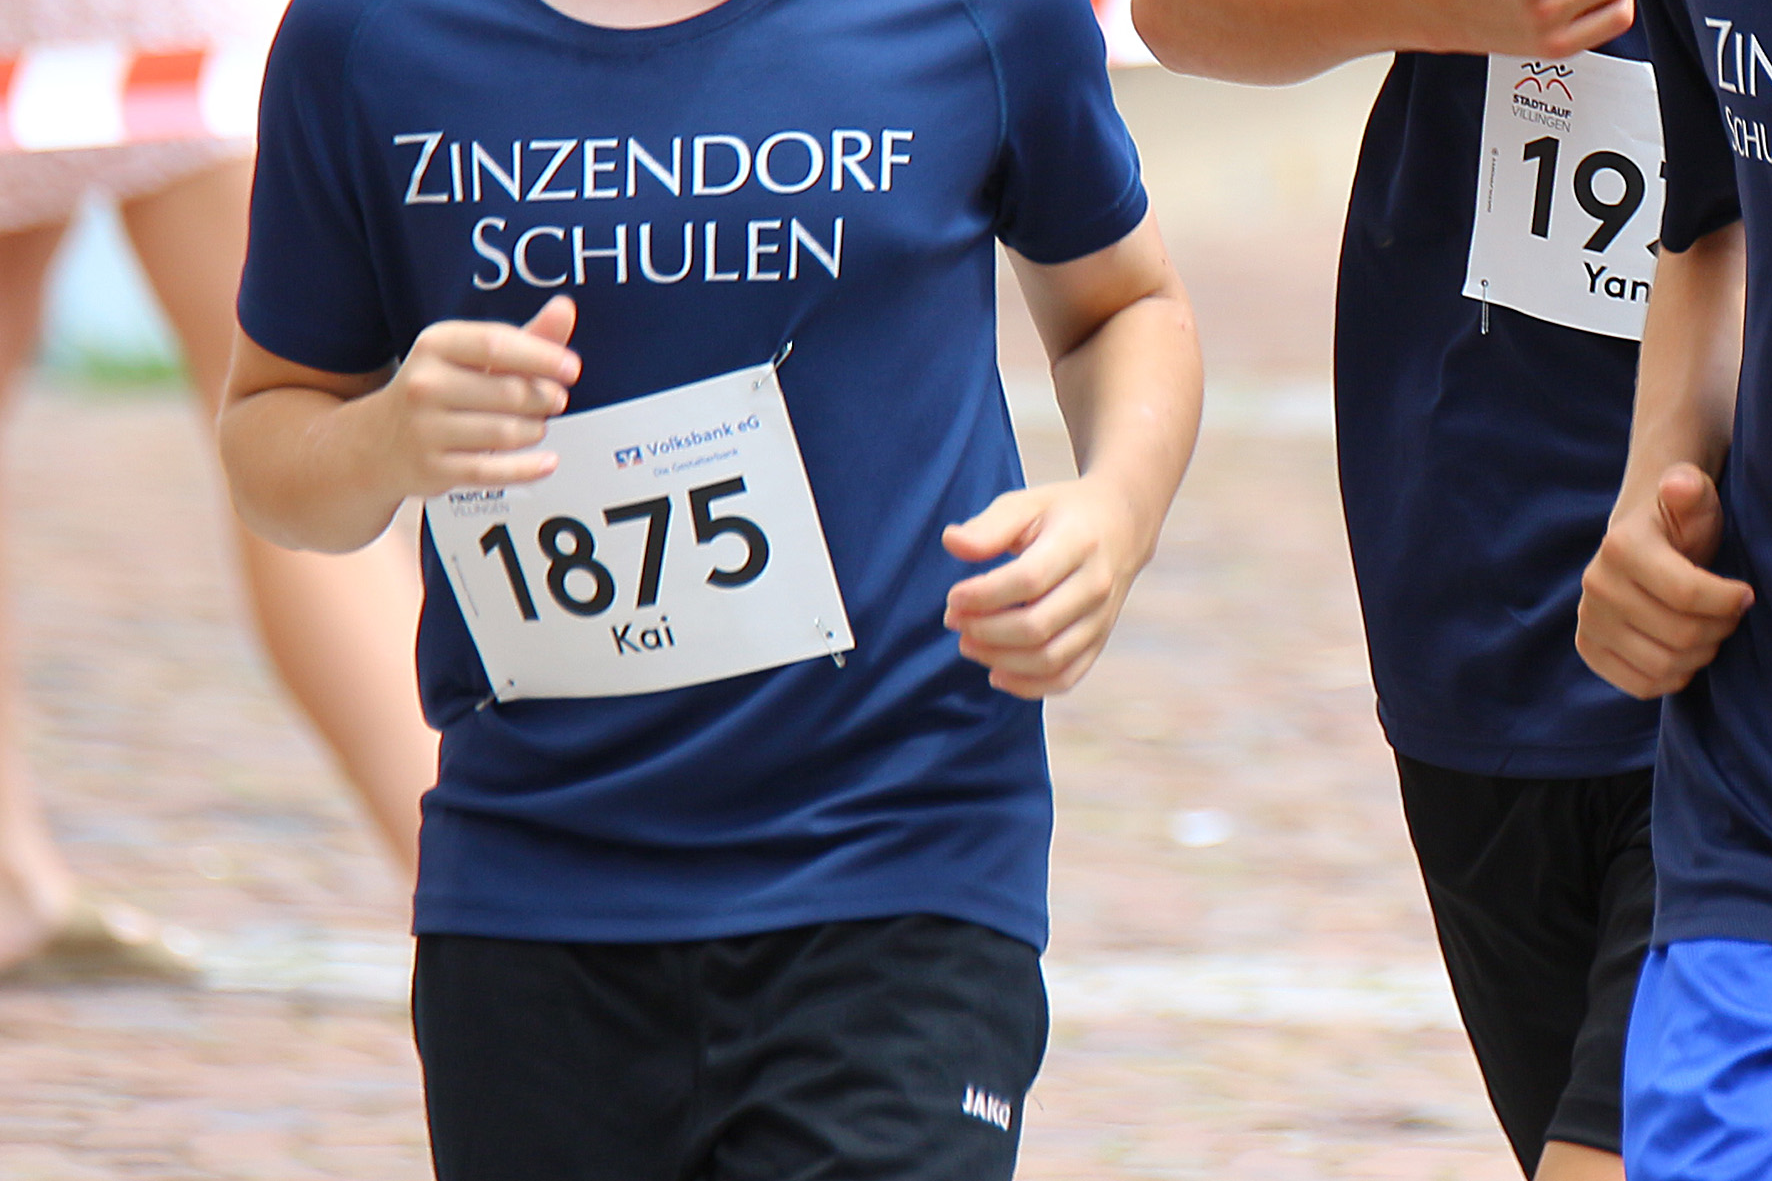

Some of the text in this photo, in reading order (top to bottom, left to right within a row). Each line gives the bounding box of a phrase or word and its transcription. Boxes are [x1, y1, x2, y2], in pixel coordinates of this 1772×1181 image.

[1511, 105, 1572, 133] VILLINGEN
[1512, 94, 1573, 119] STADTLAUF
[393, 129, 914, 205] ZINZENDORF
[1522, 135, 1667, 255] 19
[471, 216, 845, 291] SCHULEN
[646, 414, 761, 459] Volksbank eG
[478, 475, 771, 623] 1875
[610, 615, 676, 656] Kai
[962, 1084, 1011, 1132] JAKO
